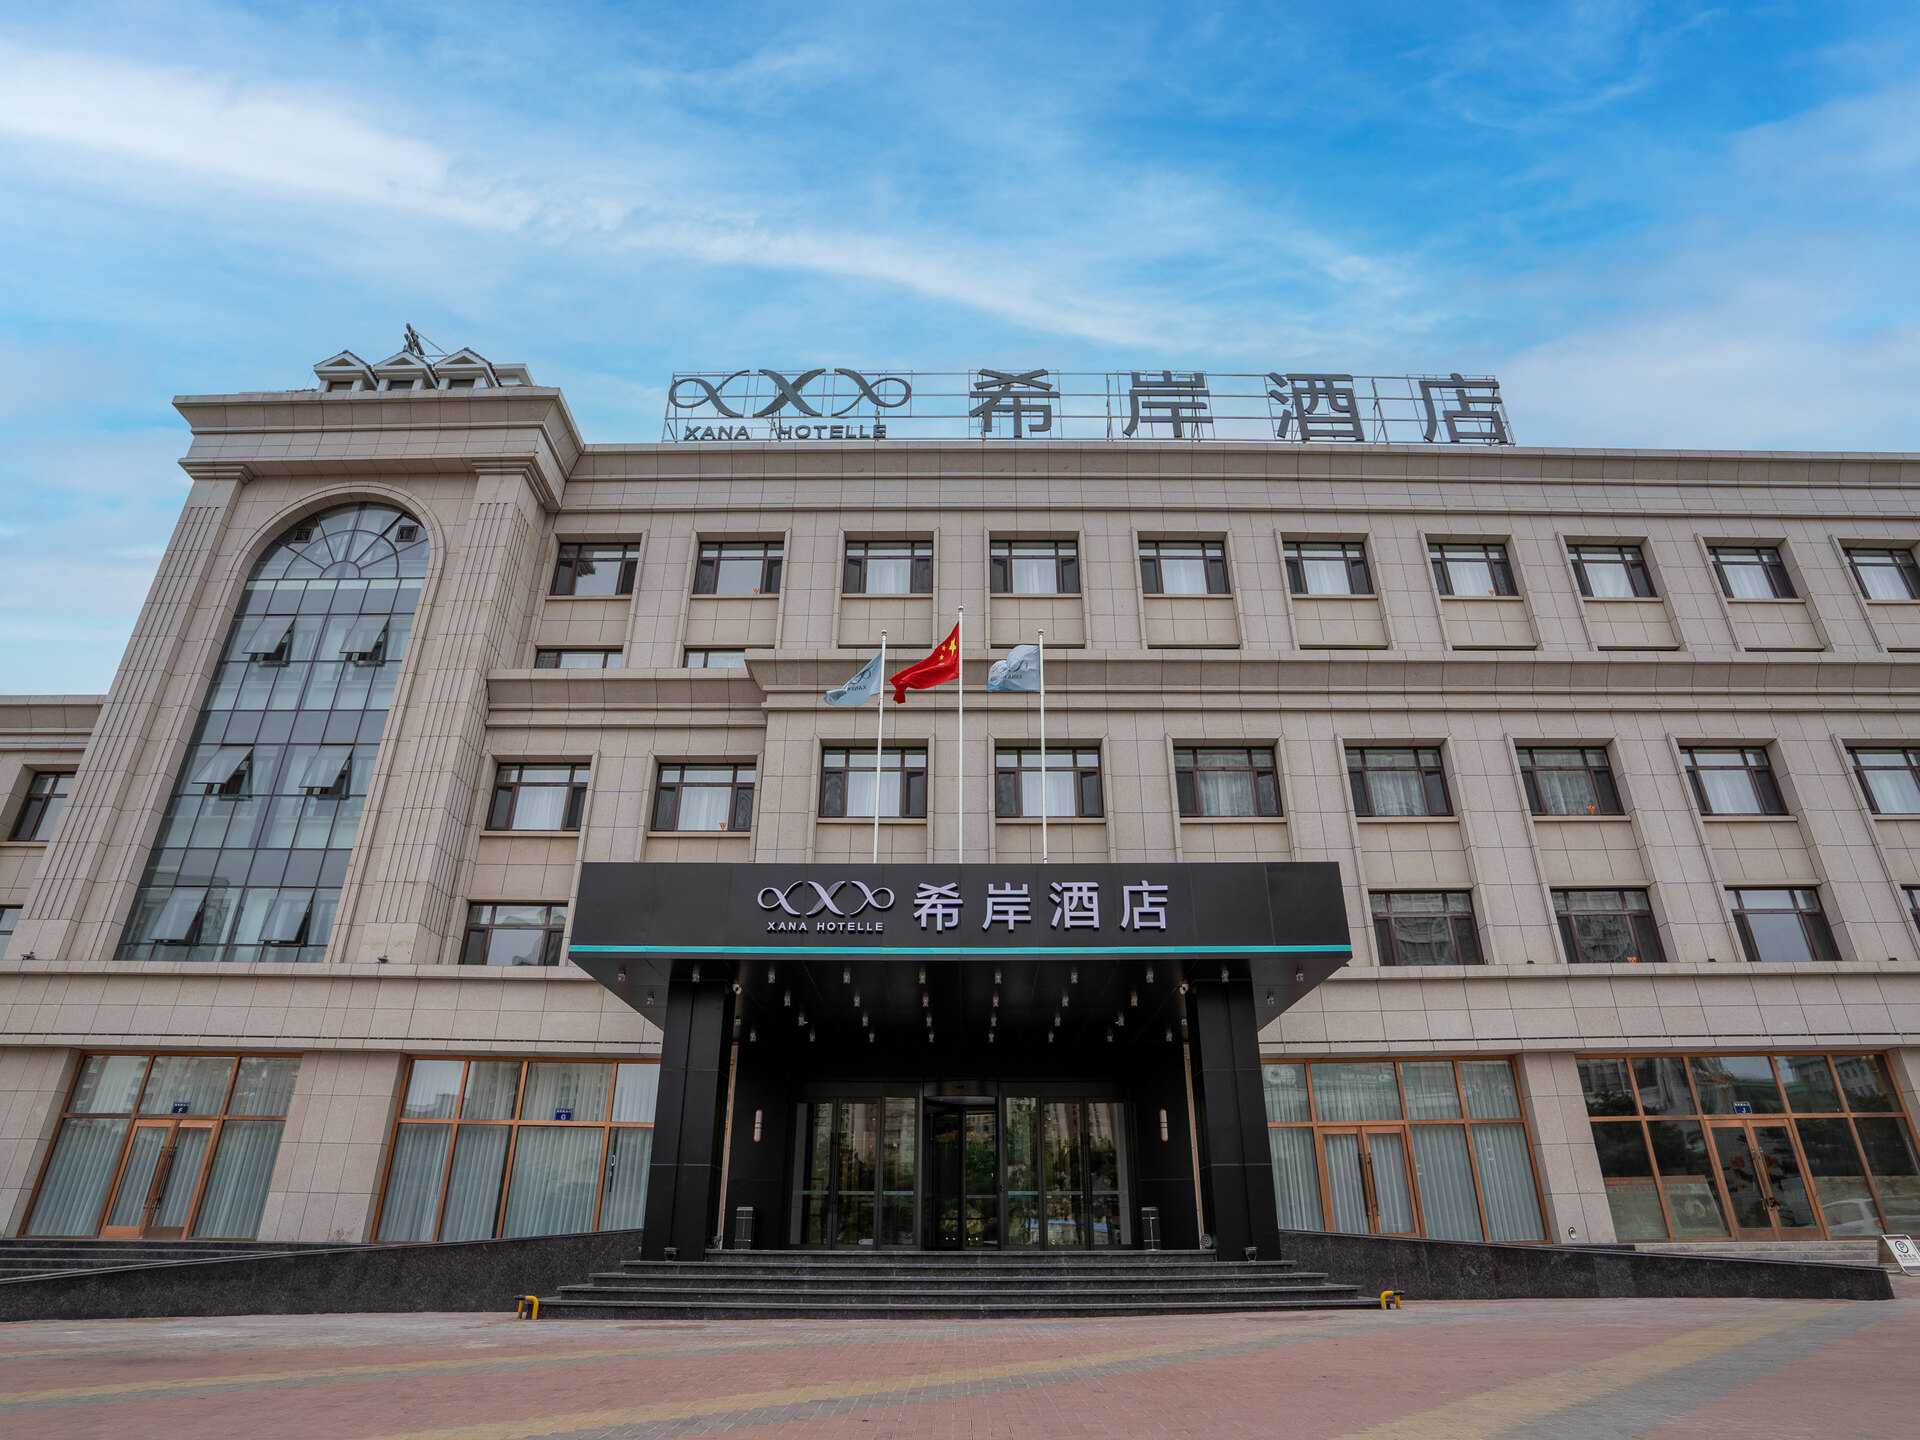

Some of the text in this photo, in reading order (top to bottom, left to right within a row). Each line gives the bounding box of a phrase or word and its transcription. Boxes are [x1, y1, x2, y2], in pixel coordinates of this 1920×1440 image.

[969, 368, 1508, 443] 希岸酒店
[684, 424, 887, 440] XANA HOTELLE
[914, 880, 1169, 931] 希岸酒店
[767, 921, 884, 932] XANA HOTELLE
